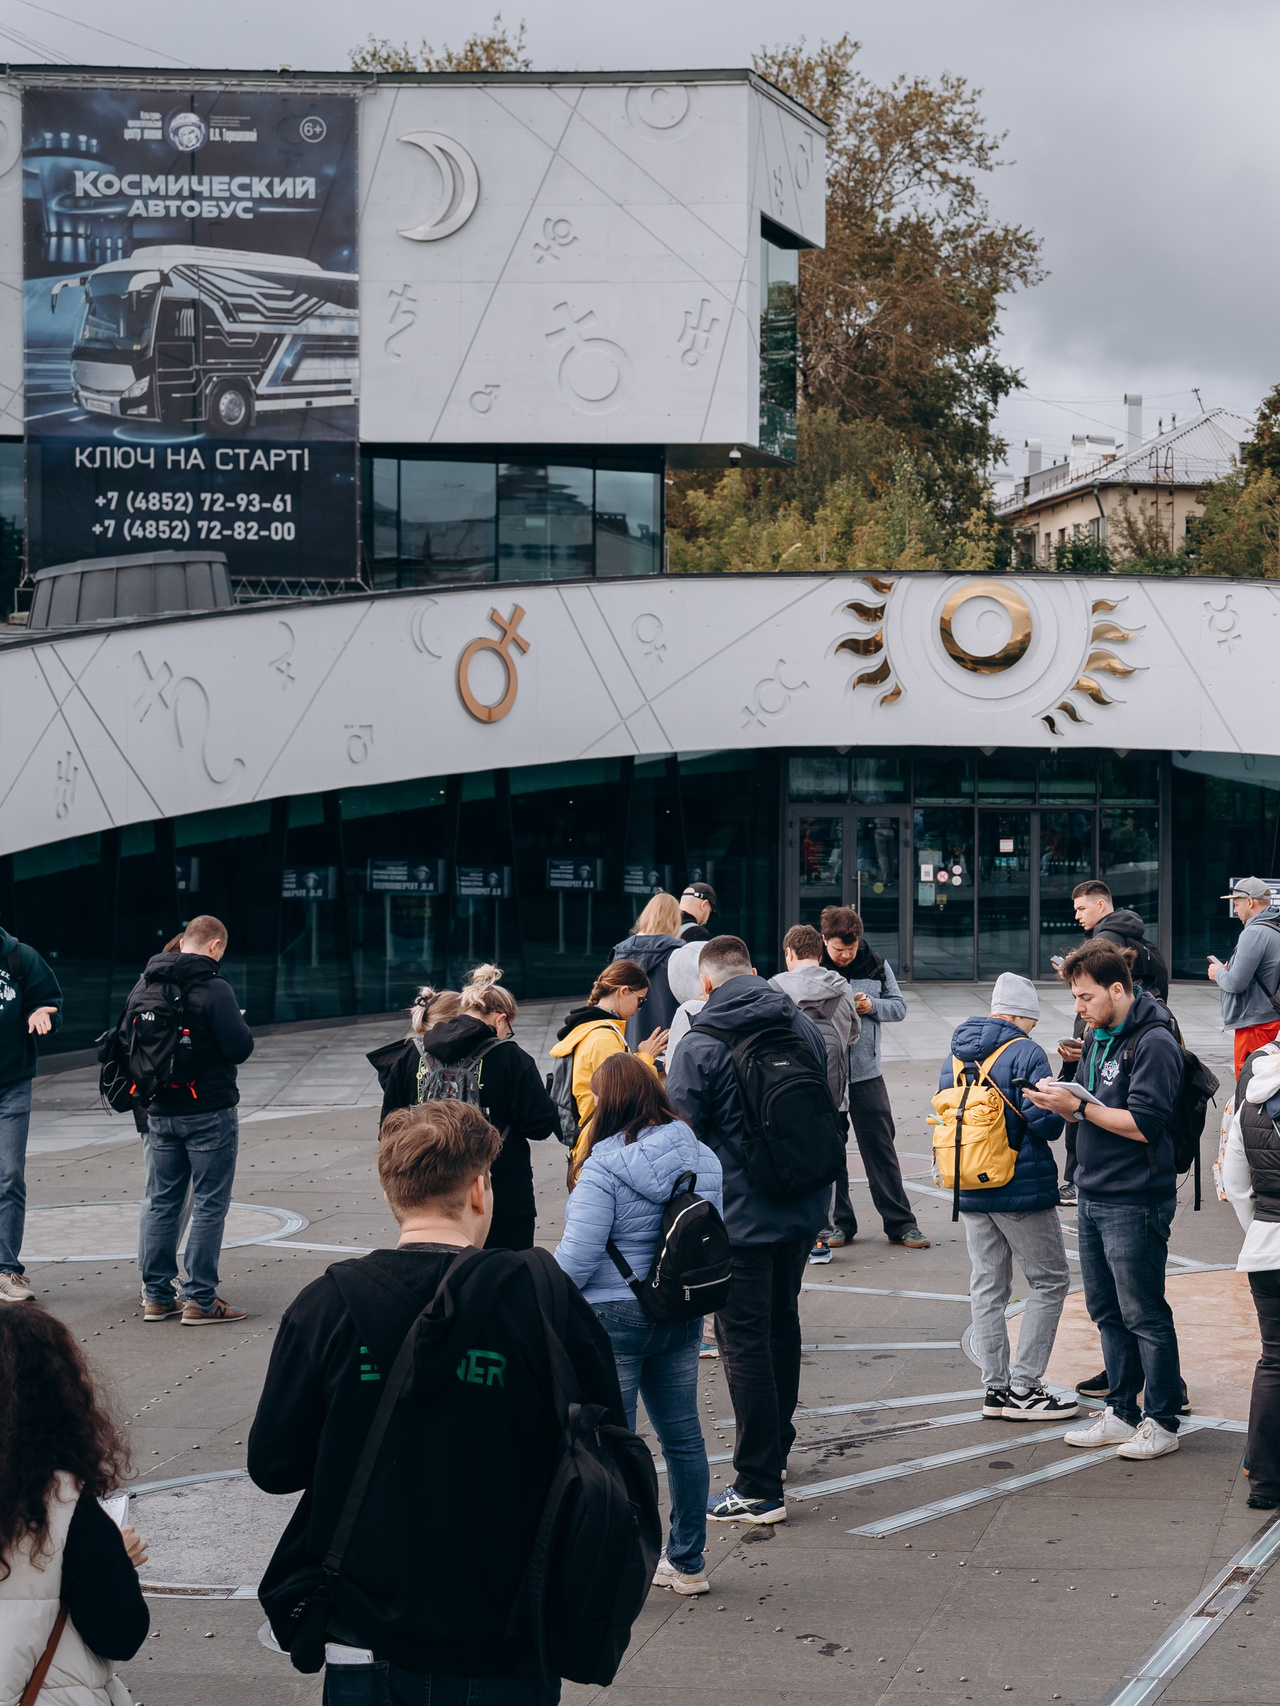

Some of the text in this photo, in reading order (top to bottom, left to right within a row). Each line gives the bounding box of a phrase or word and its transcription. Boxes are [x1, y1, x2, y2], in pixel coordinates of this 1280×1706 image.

[304, 123, 323, 136] 6+
[127, 200, 254, 219] АВТОБУС
[75, 446, 311, 472] КЛЮЧ НА СТАРТ!
[95, 490, 292, 513] +7 (4852) 72-93-61
[92, 519, 296, 542] +7 (4852) 72-82-00
